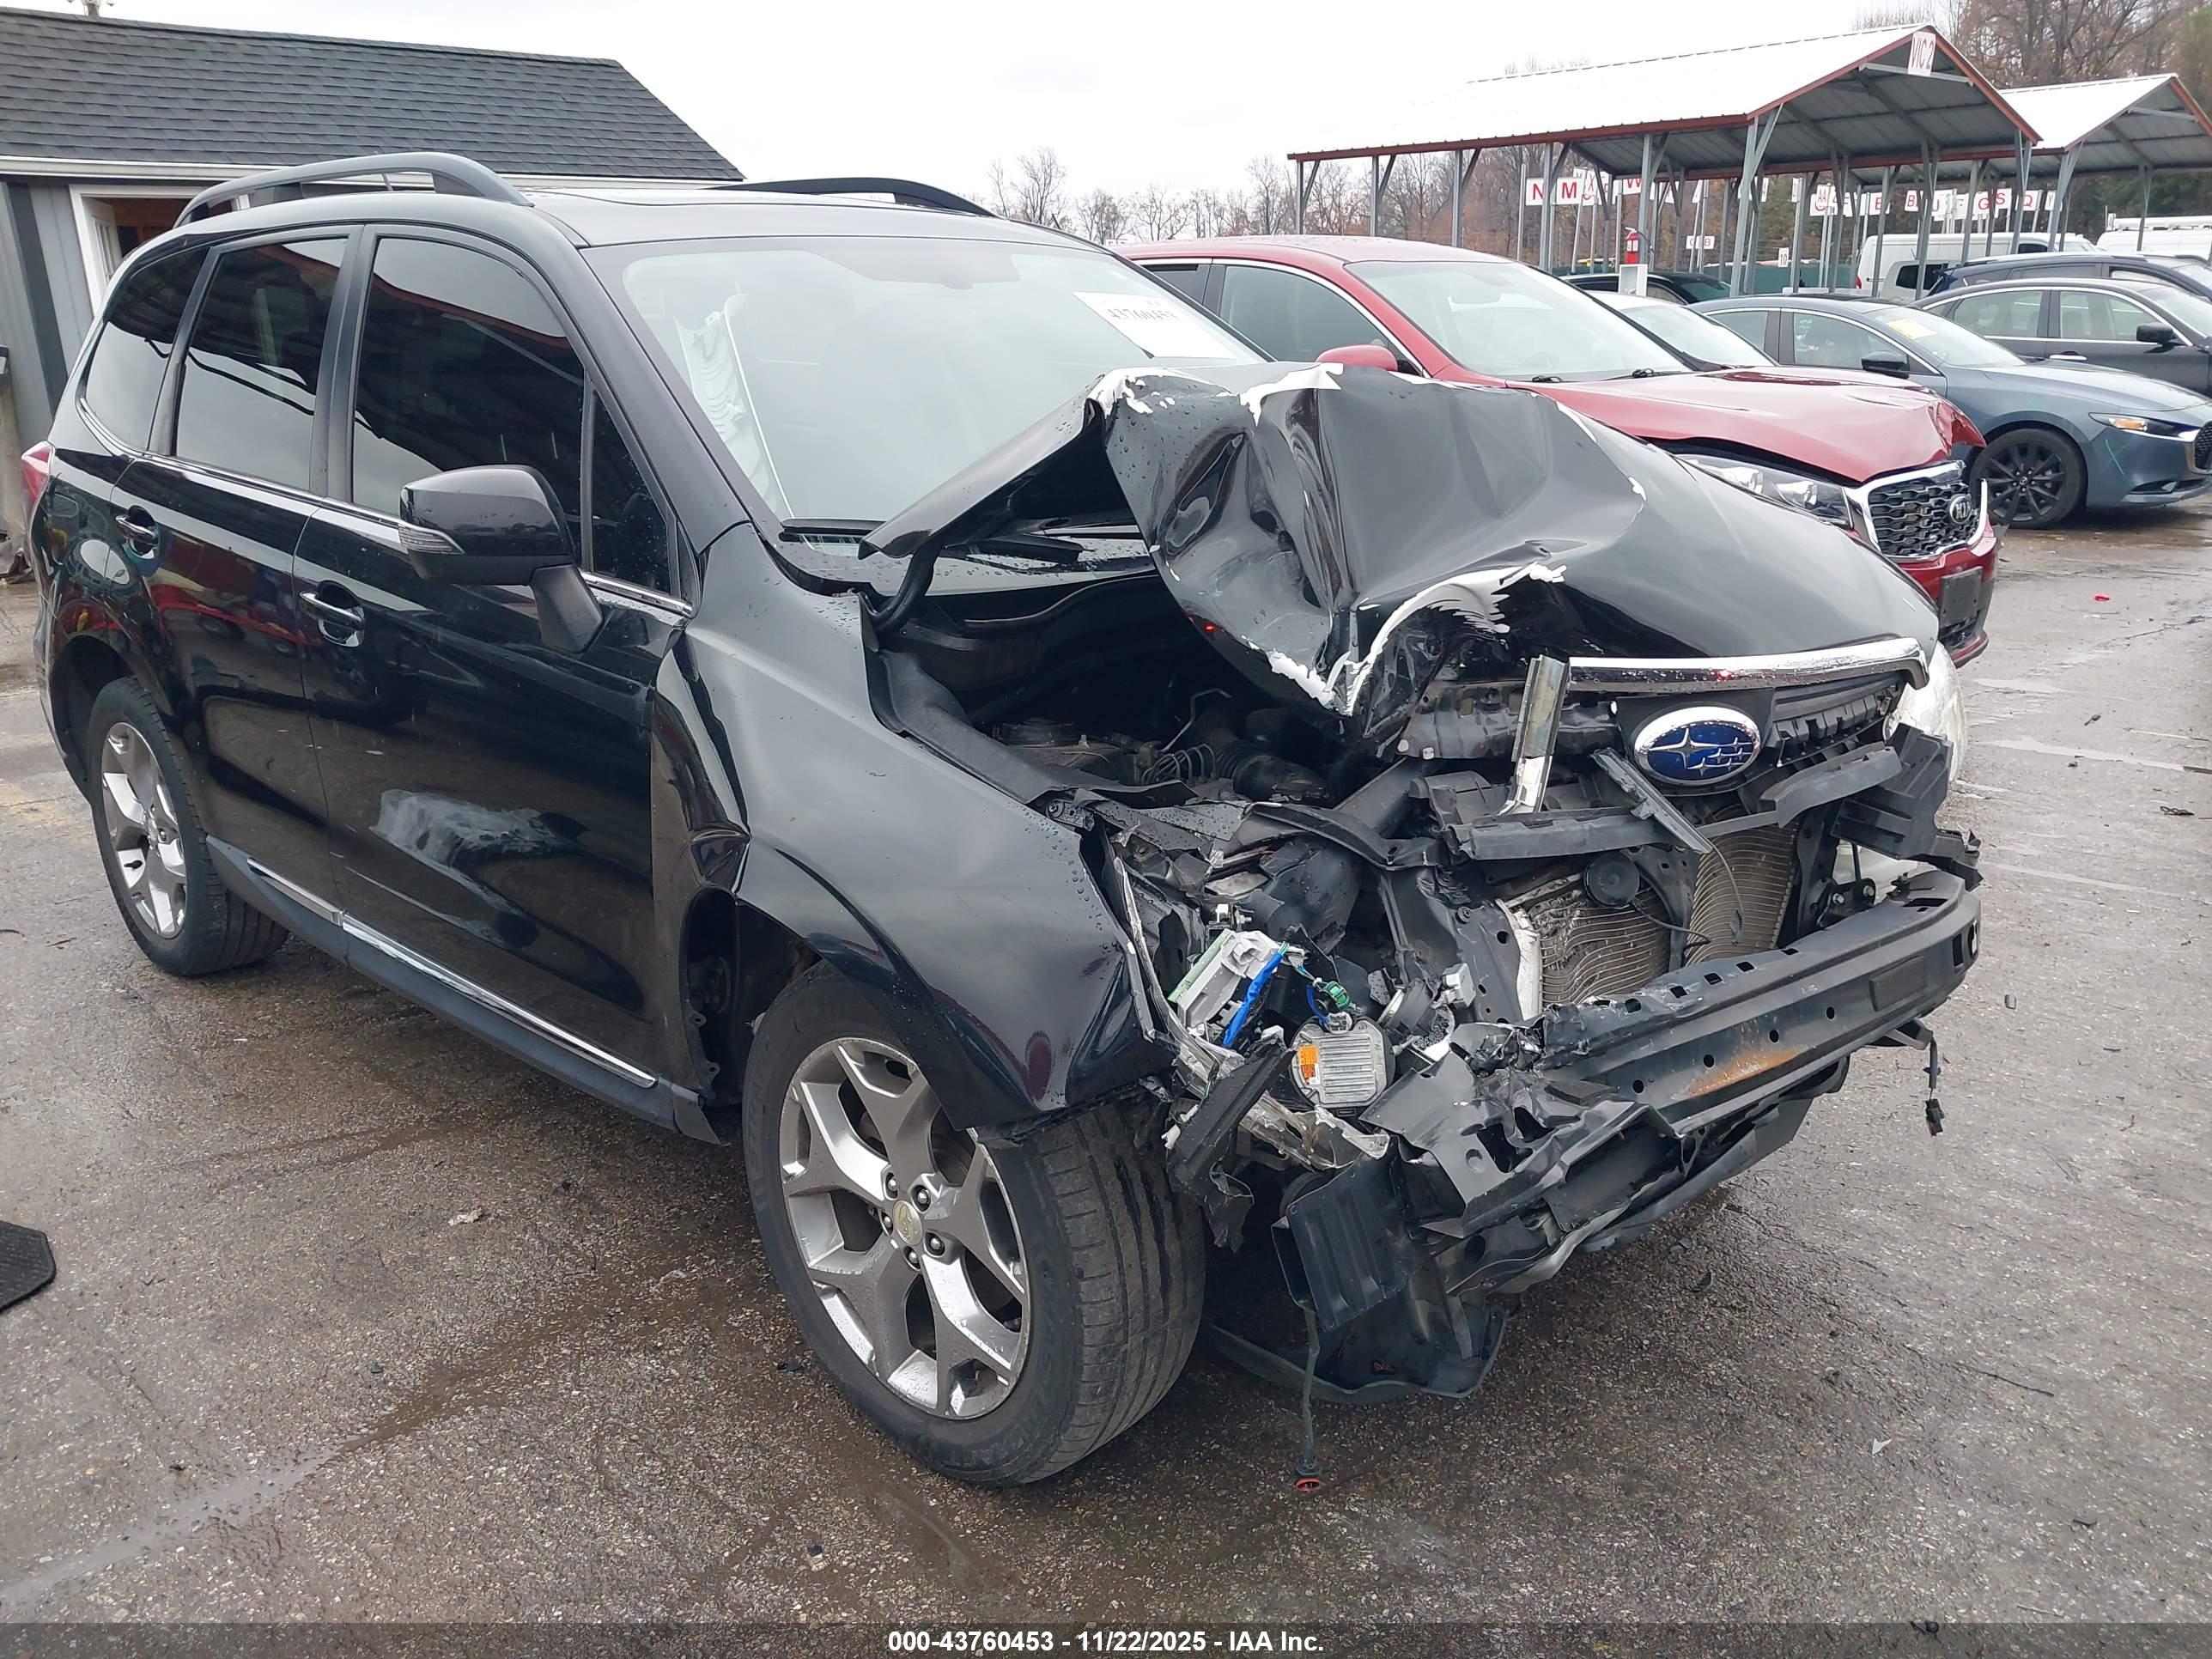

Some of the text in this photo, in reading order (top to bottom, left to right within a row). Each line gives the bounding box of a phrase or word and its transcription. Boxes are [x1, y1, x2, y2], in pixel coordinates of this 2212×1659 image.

[1911, 37, 1934, 70] VIC 2
[1561, 181, 1577, 199] M
[1996, 192, 2006, 205] S
[1780, 253, 1788, 266] 10
